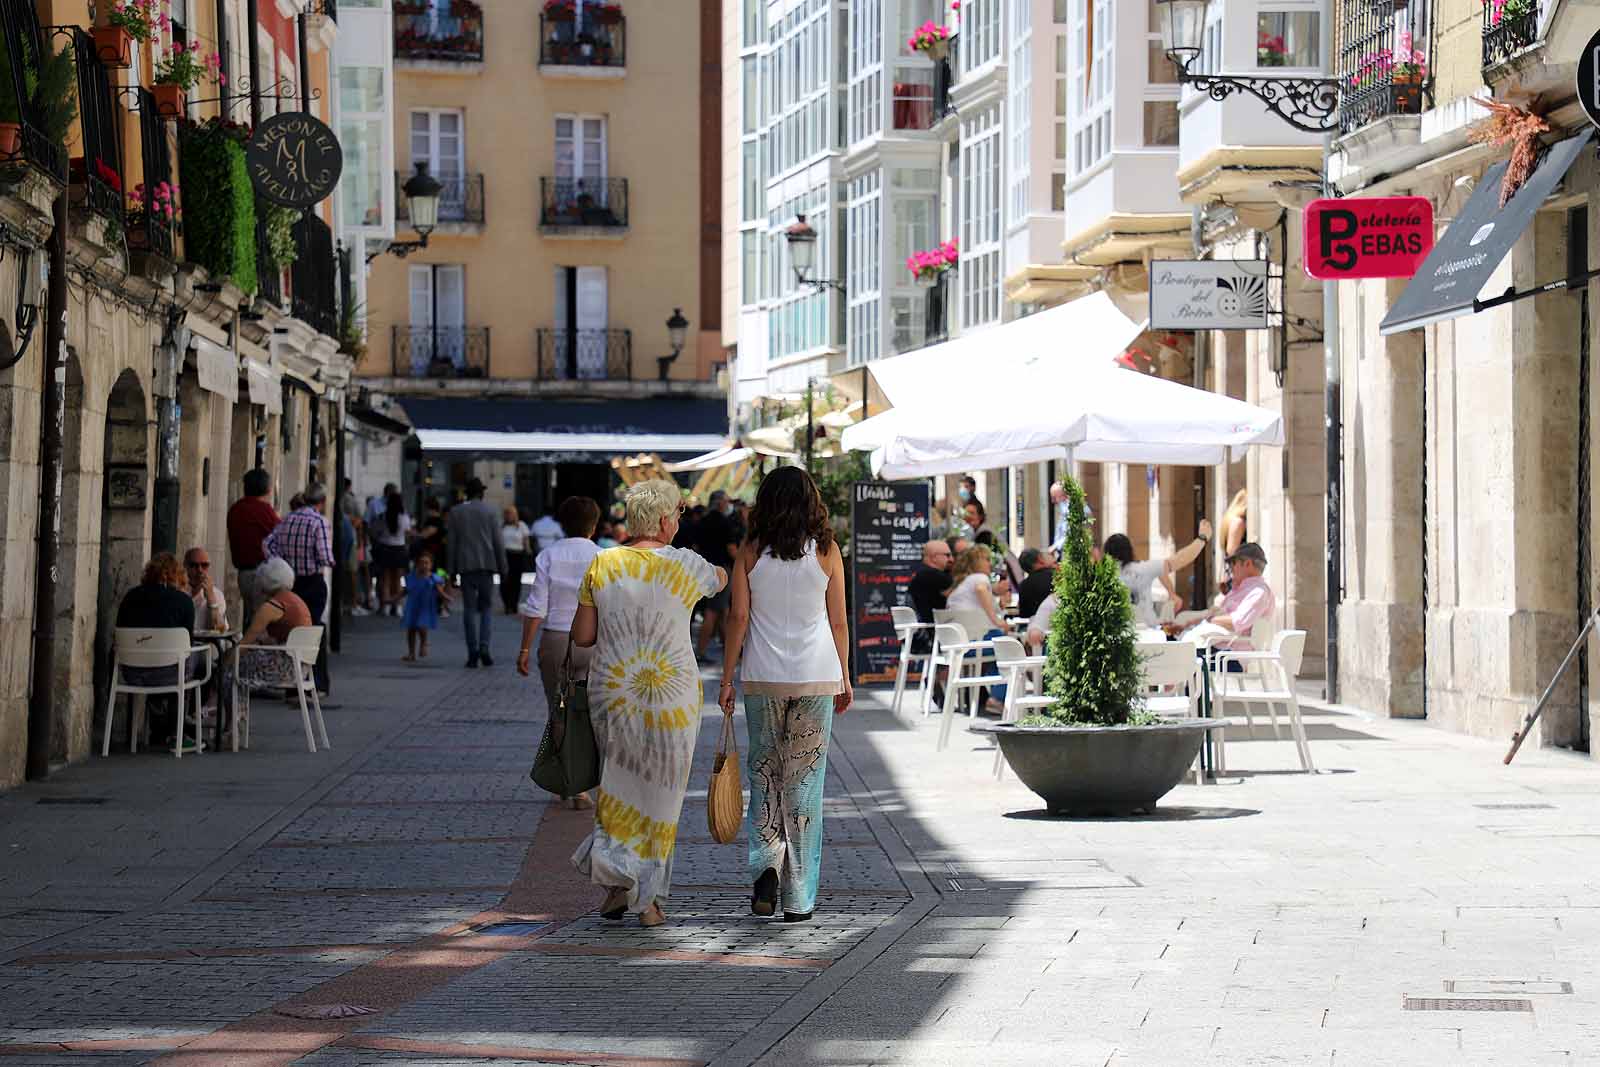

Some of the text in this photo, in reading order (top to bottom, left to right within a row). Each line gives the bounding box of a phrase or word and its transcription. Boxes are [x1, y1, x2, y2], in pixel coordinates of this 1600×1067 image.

[315, 136, 334, 155] EL
[1153, 271, 1215, 289] Boutique
[1191, 289, 1214, 303] del
